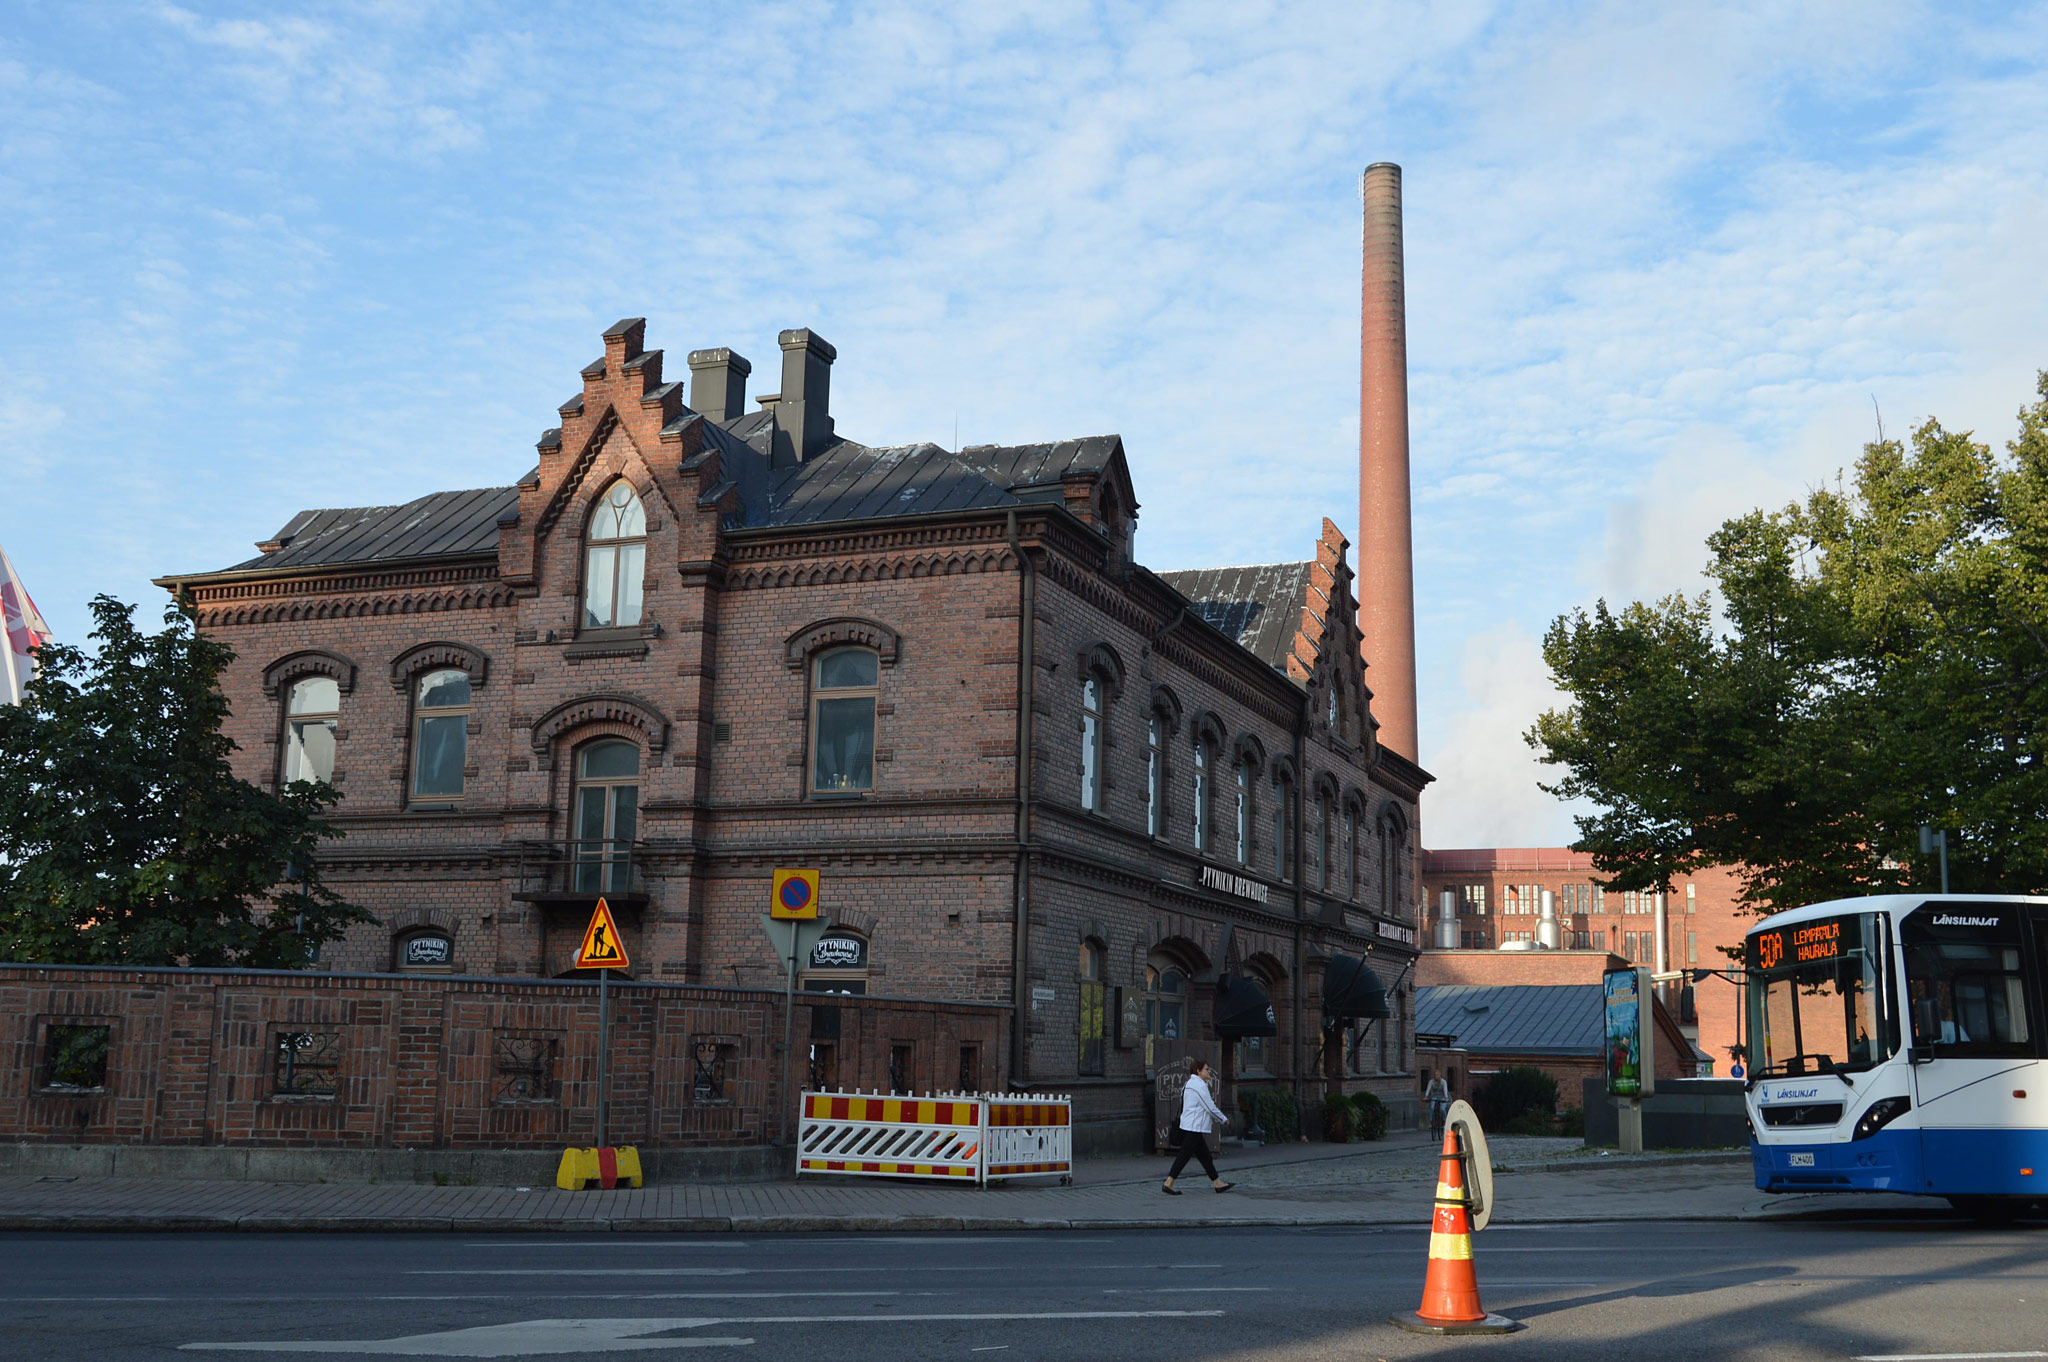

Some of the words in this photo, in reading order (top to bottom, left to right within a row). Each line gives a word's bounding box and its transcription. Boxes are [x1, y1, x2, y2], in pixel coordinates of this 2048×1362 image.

[1203, 866, 1234, 893] PYYNIKIN
[1234, 876, 1268, 903] BREWHOUSE
[1932, 913, 1999, 926] LÄNSILINJAT
[412, 939, 445, 949] PYYNIKIN
[818, 940, 856, 951] PYYNIKIN
[1760, 932, 1783, 969] 50A
[1798, 941, 1838, 961] HAURALA
[1777, 1089, 1818, 1099] LÄNSILINJAT
